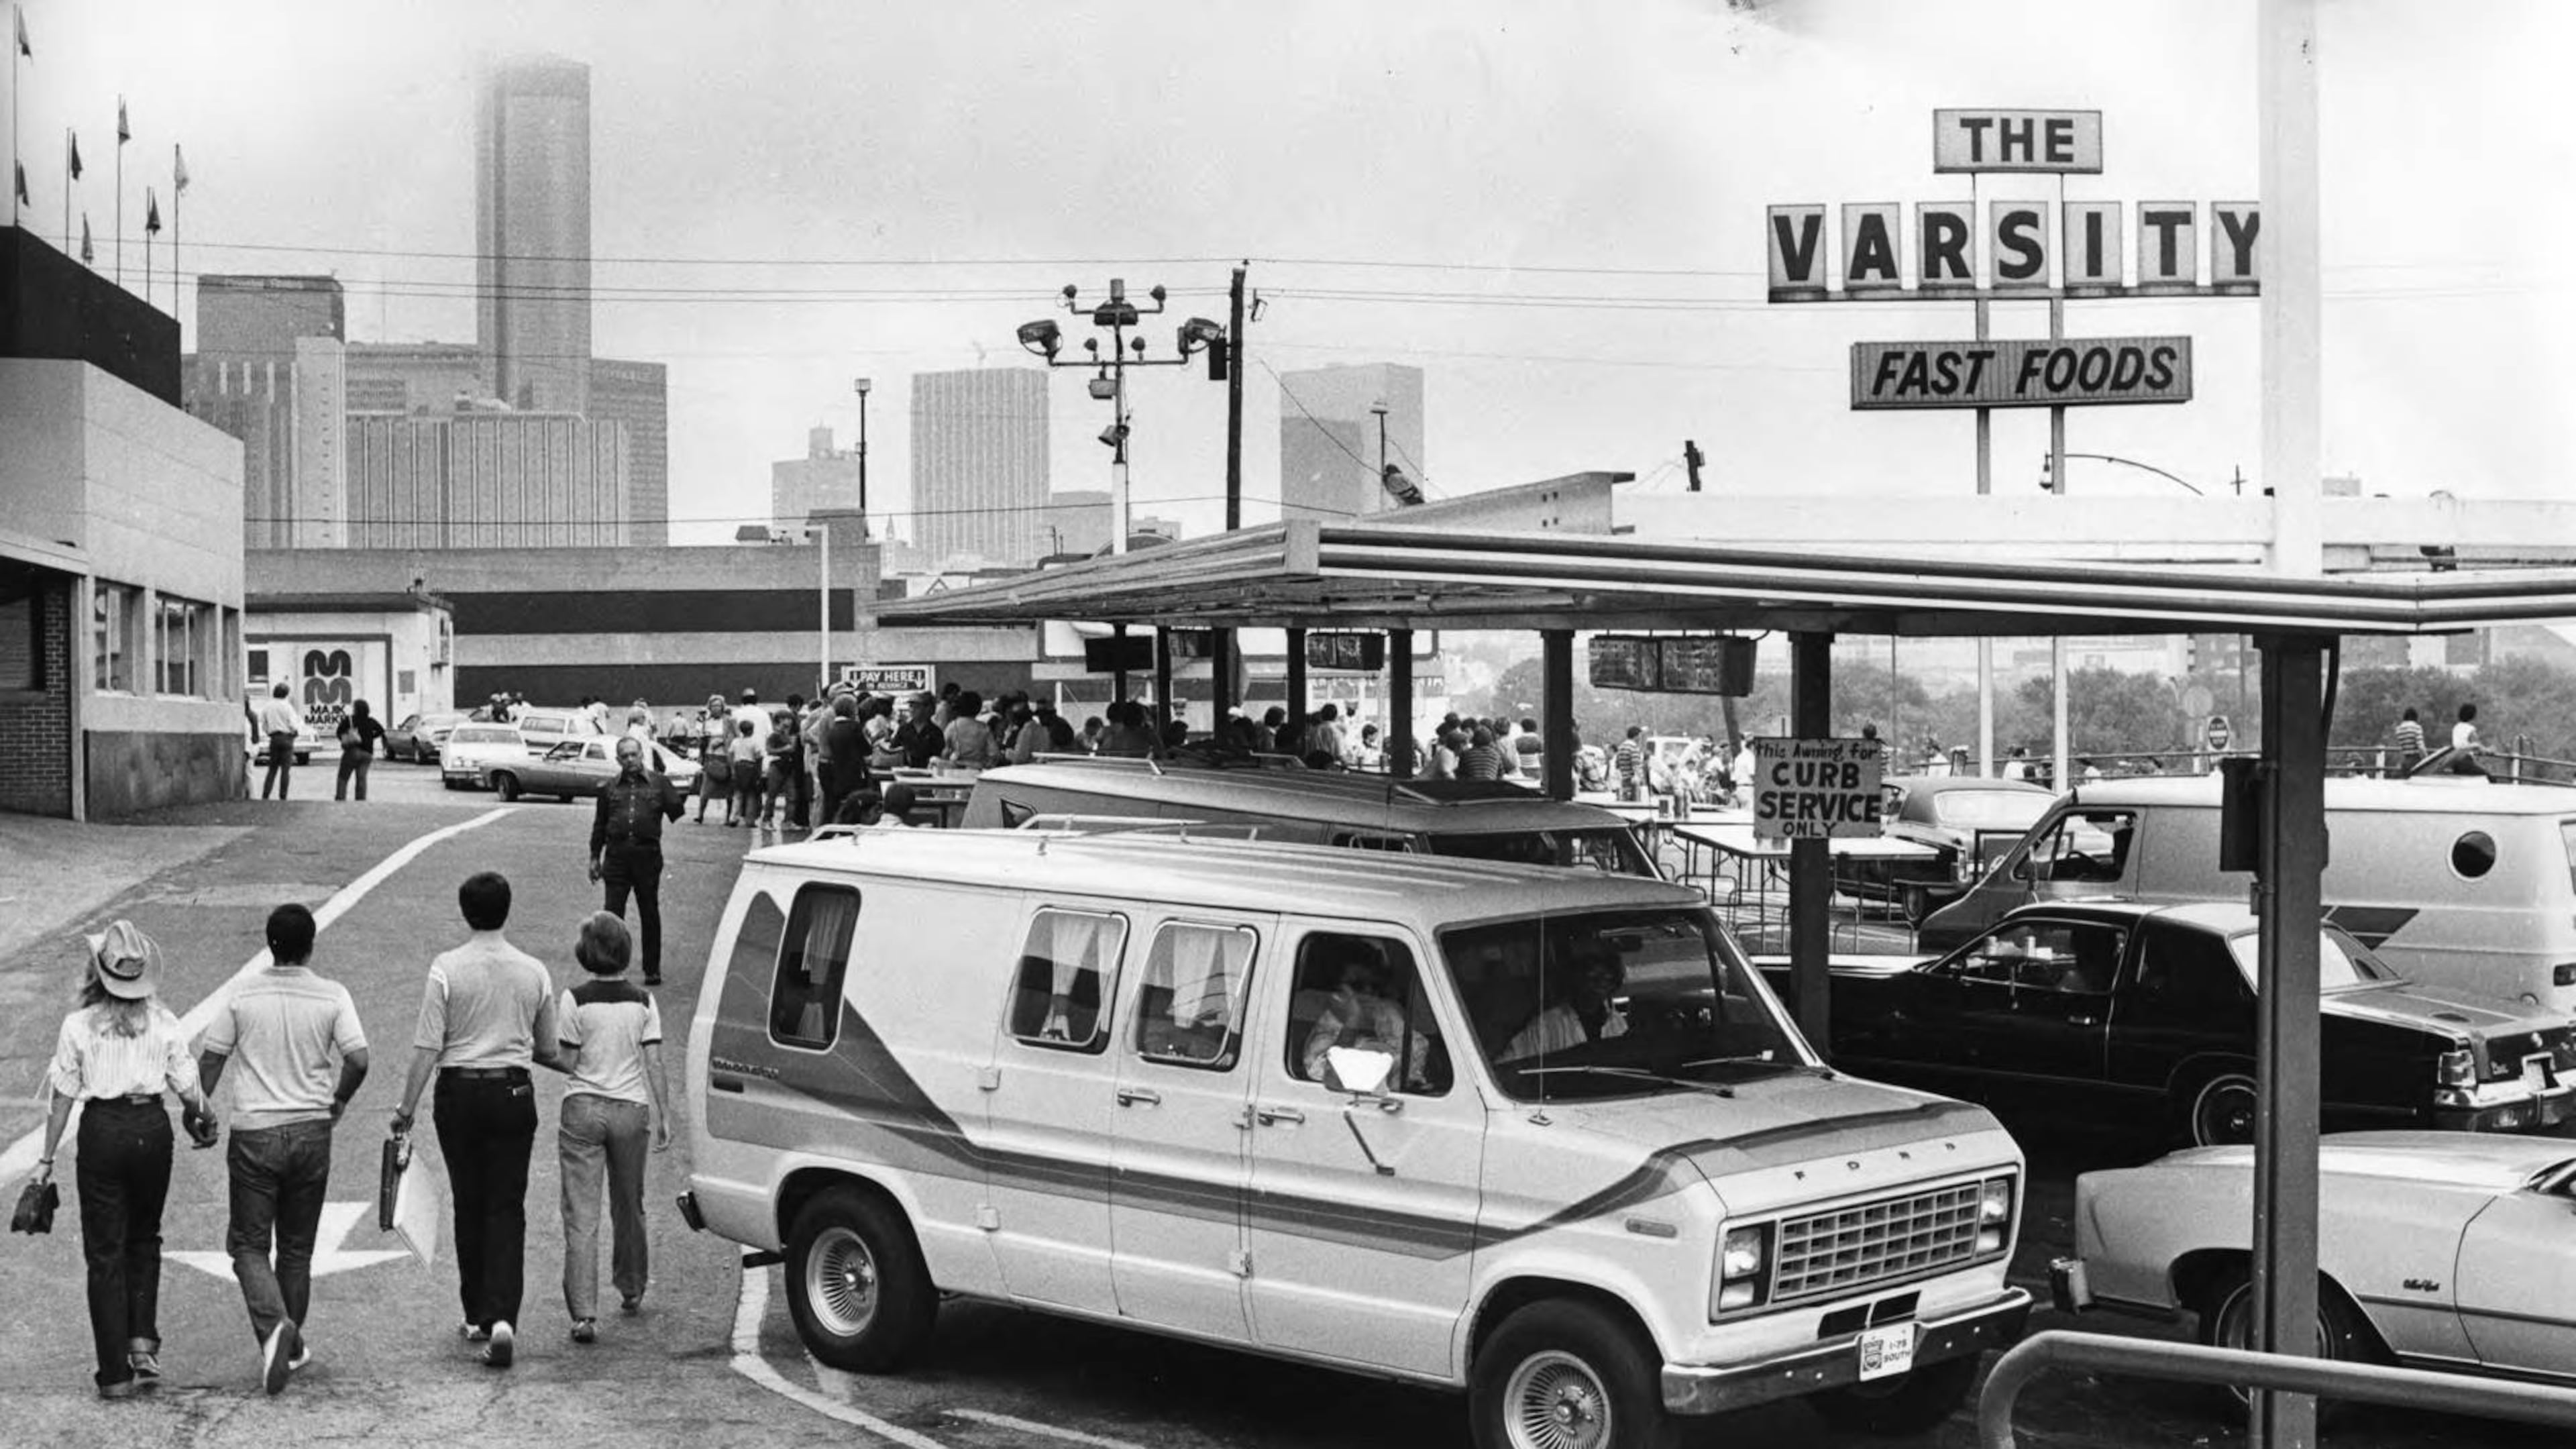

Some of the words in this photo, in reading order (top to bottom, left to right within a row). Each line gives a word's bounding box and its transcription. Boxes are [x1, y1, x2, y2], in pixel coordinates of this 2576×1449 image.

[1960, 118, 2074, 162] THE
[1773, 210, 2259, 280] VARSITY
[1872, 350, 1995, 397] FAST
[2015, 345, 2177, 394] FOODS
[860, 672, 880, 682] PAY
[884, 672, 914, 682] HERE
[1792, 743, 1844, 762] Awning
[1850, 743, 1878, 760] for
[1772, 762, 1860, 789] CURB
[1758, 792, 1882, 822] SERVICE
[1783, 822, 1837, 837] ONLY
